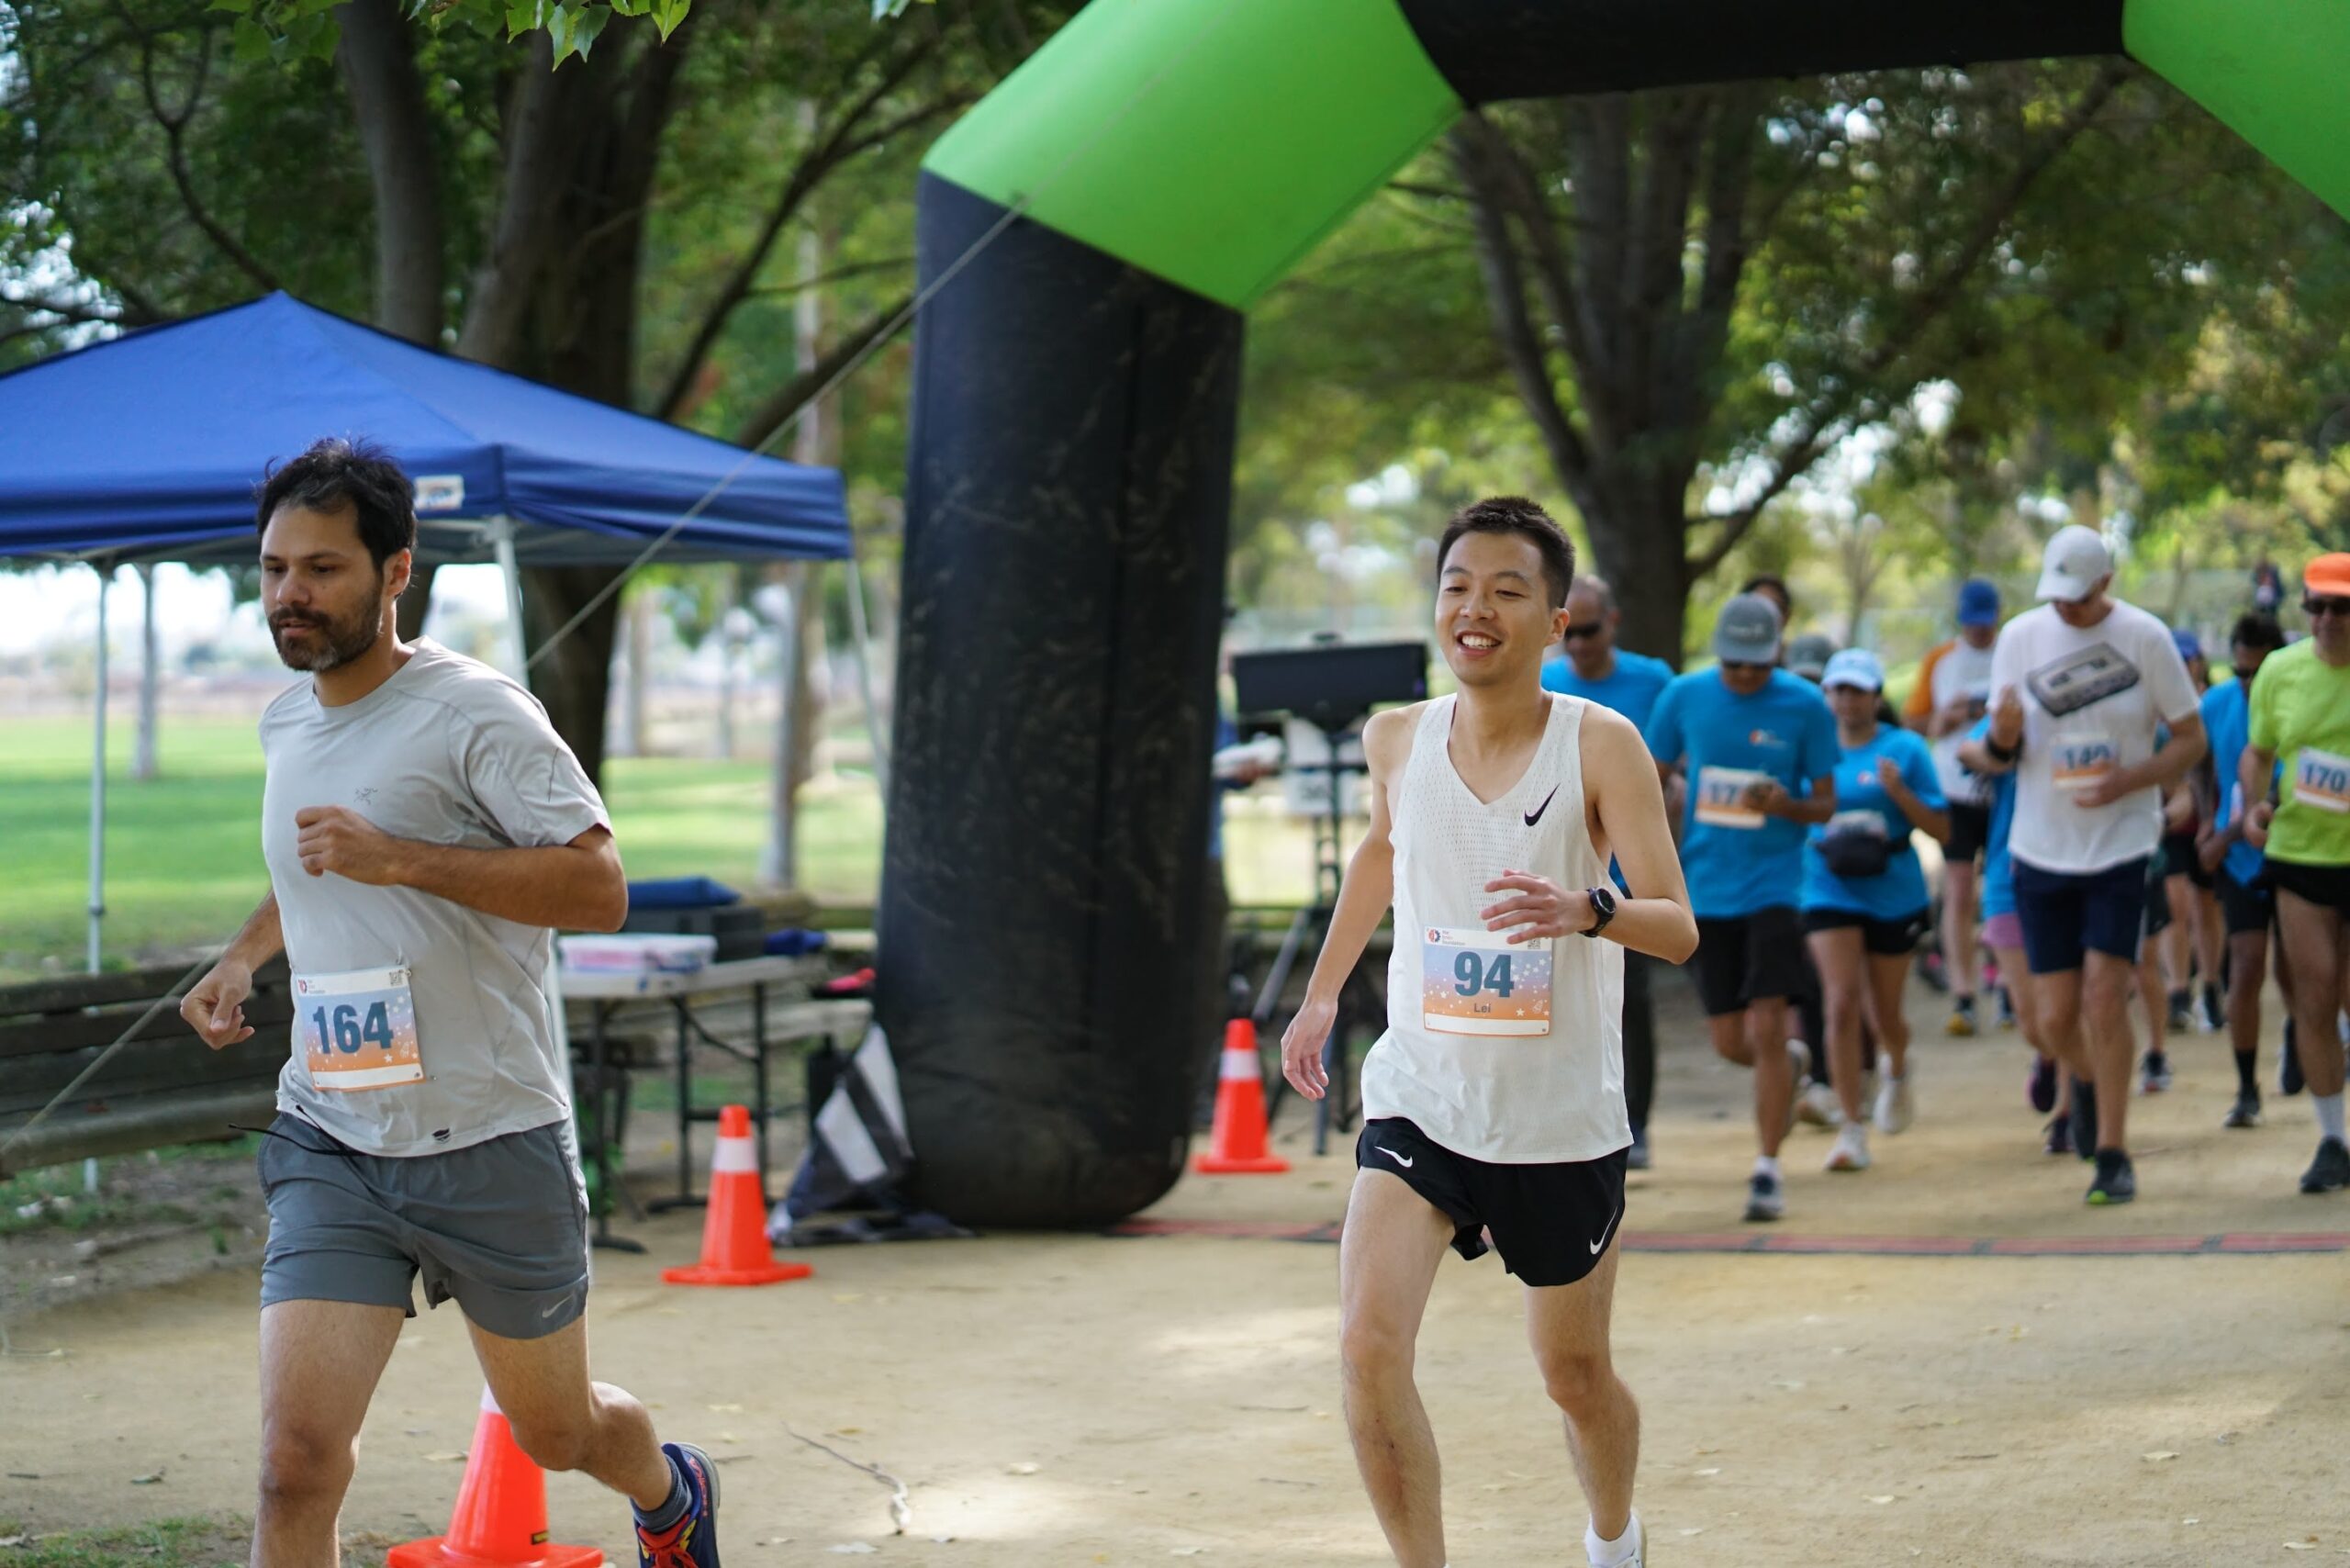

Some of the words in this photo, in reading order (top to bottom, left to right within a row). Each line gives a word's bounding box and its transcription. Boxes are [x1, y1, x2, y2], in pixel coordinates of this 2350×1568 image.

[1709, 781, 1740, 805] 17
[2304, 762, 2346, 794] 170
[1454, 951, 1515, 998] 94
[1473, 1002, 1492, 1014] Lei
[312, 1001, 395, 1055] 164
